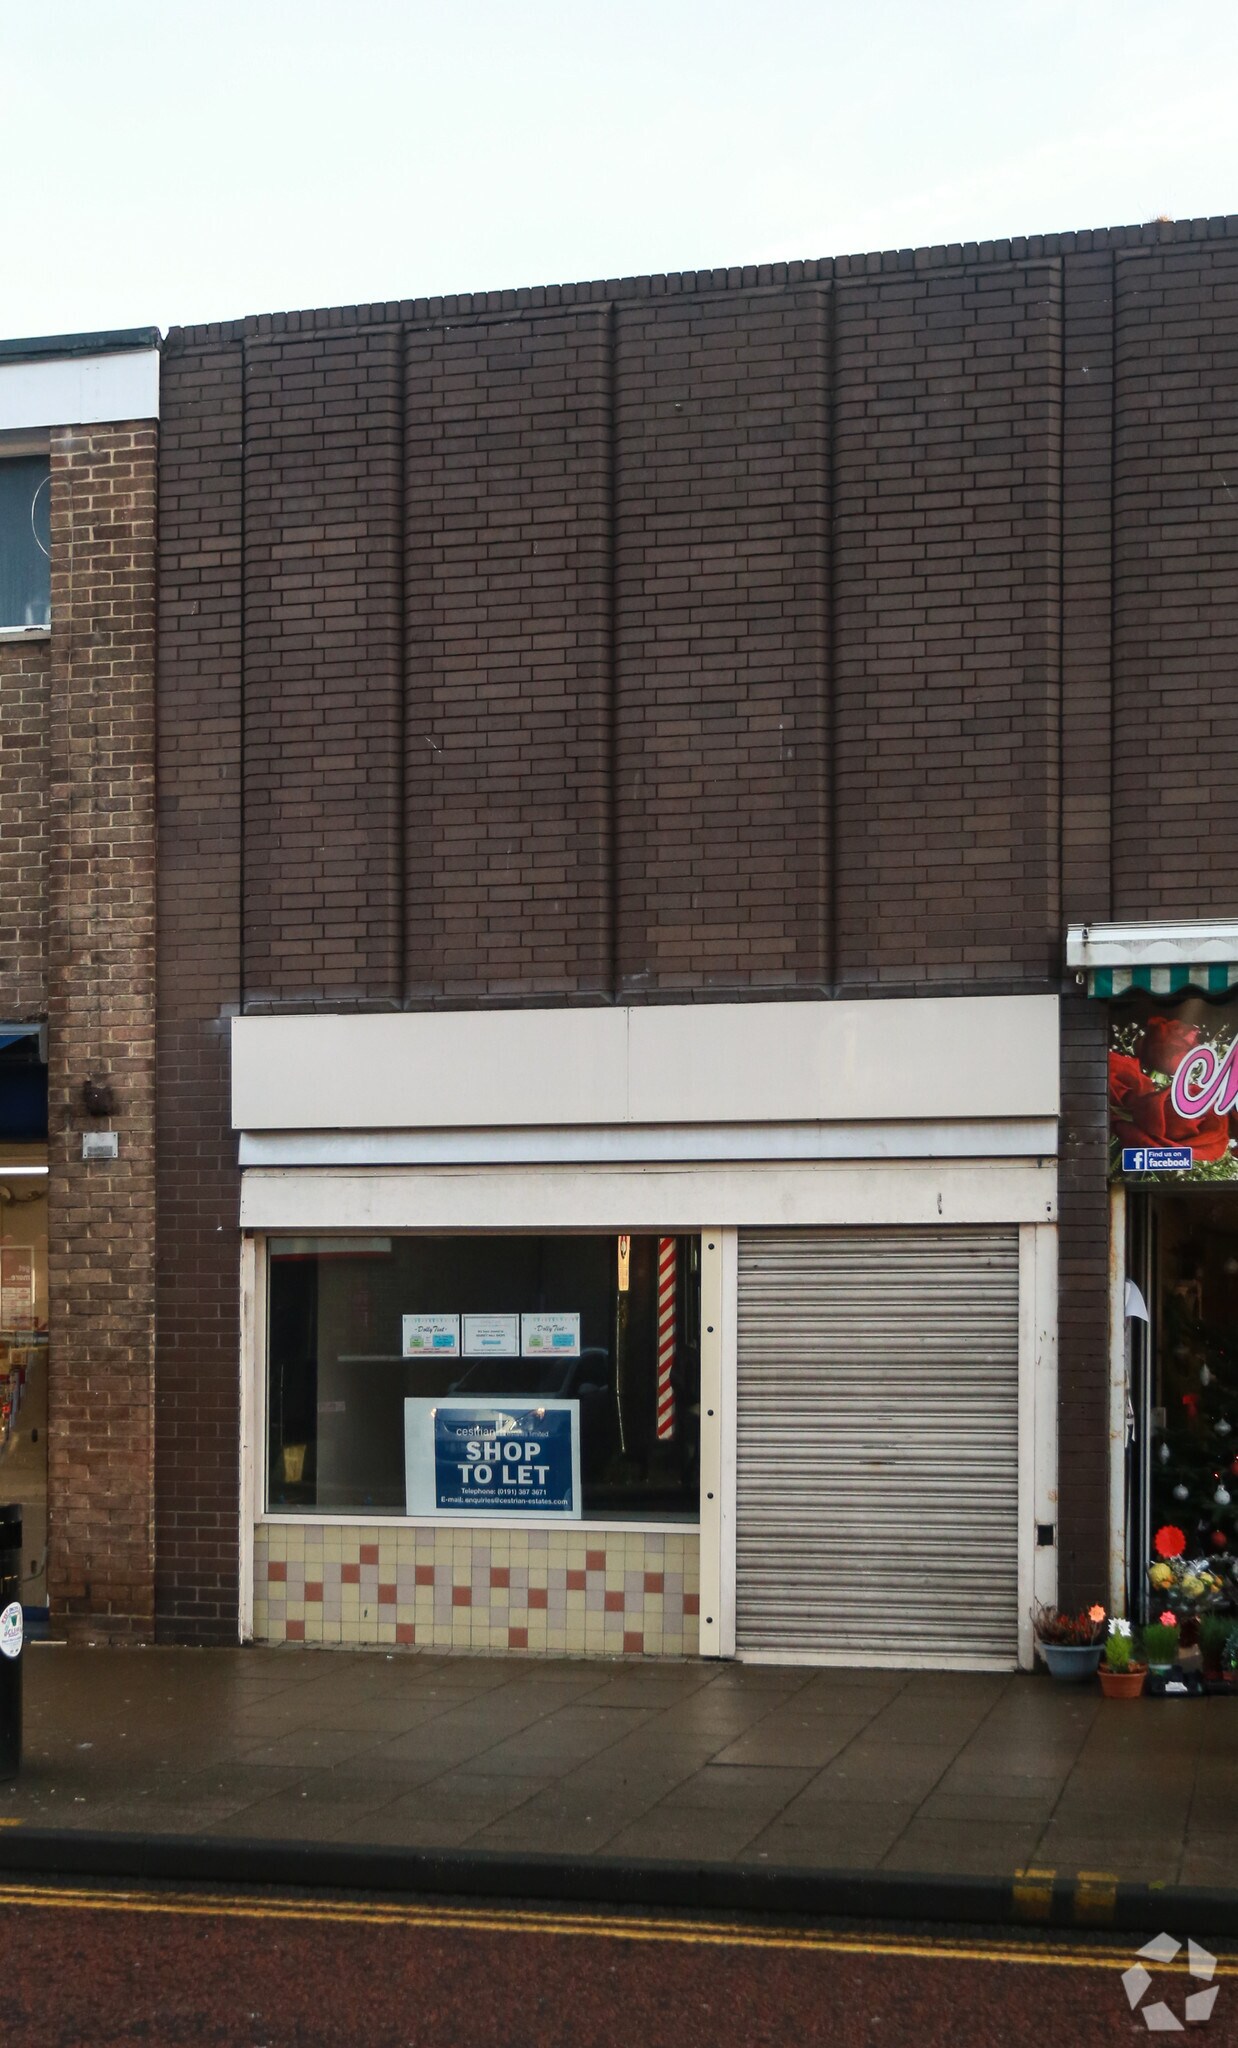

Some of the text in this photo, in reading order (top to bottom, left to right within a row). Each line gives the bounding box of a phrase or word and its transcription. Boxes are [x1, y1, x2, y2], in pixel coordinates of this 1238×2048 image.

[1133, 1151, 1143, 1169] f
[1148, 1157, 1190, 1167] facebook
[456, 1426, 495, 1437] cestrian
[466, 1441, 541, 1462] SHOP
[457, 1464, 550, 1485] TO LET
[461, 1487, 496, 1495] Telephone:
[497, 1488, 517, 1496] (0191)
